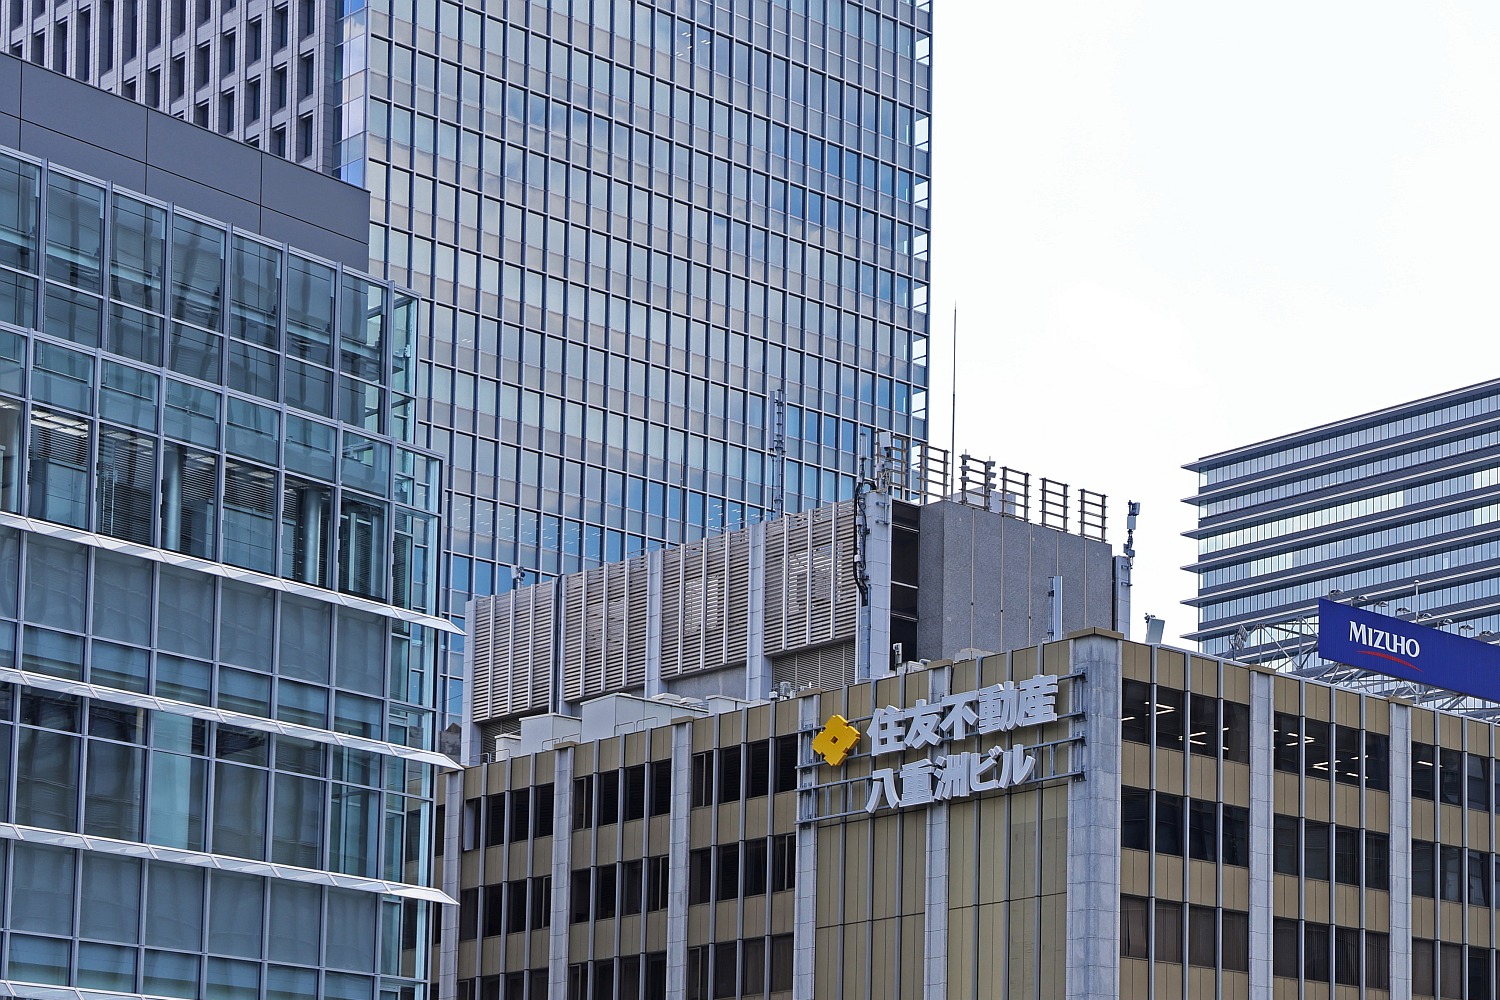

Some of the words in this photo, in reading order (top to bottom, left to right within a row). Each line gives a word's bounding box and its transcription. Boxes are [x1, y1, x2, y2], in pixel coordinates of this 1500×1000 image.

[1349, 621, 1420, 658] MIZUHO
[866, 674, 1058, 757] 住友不動産
[865, 743, 1037, 814] 八重洲ビル
